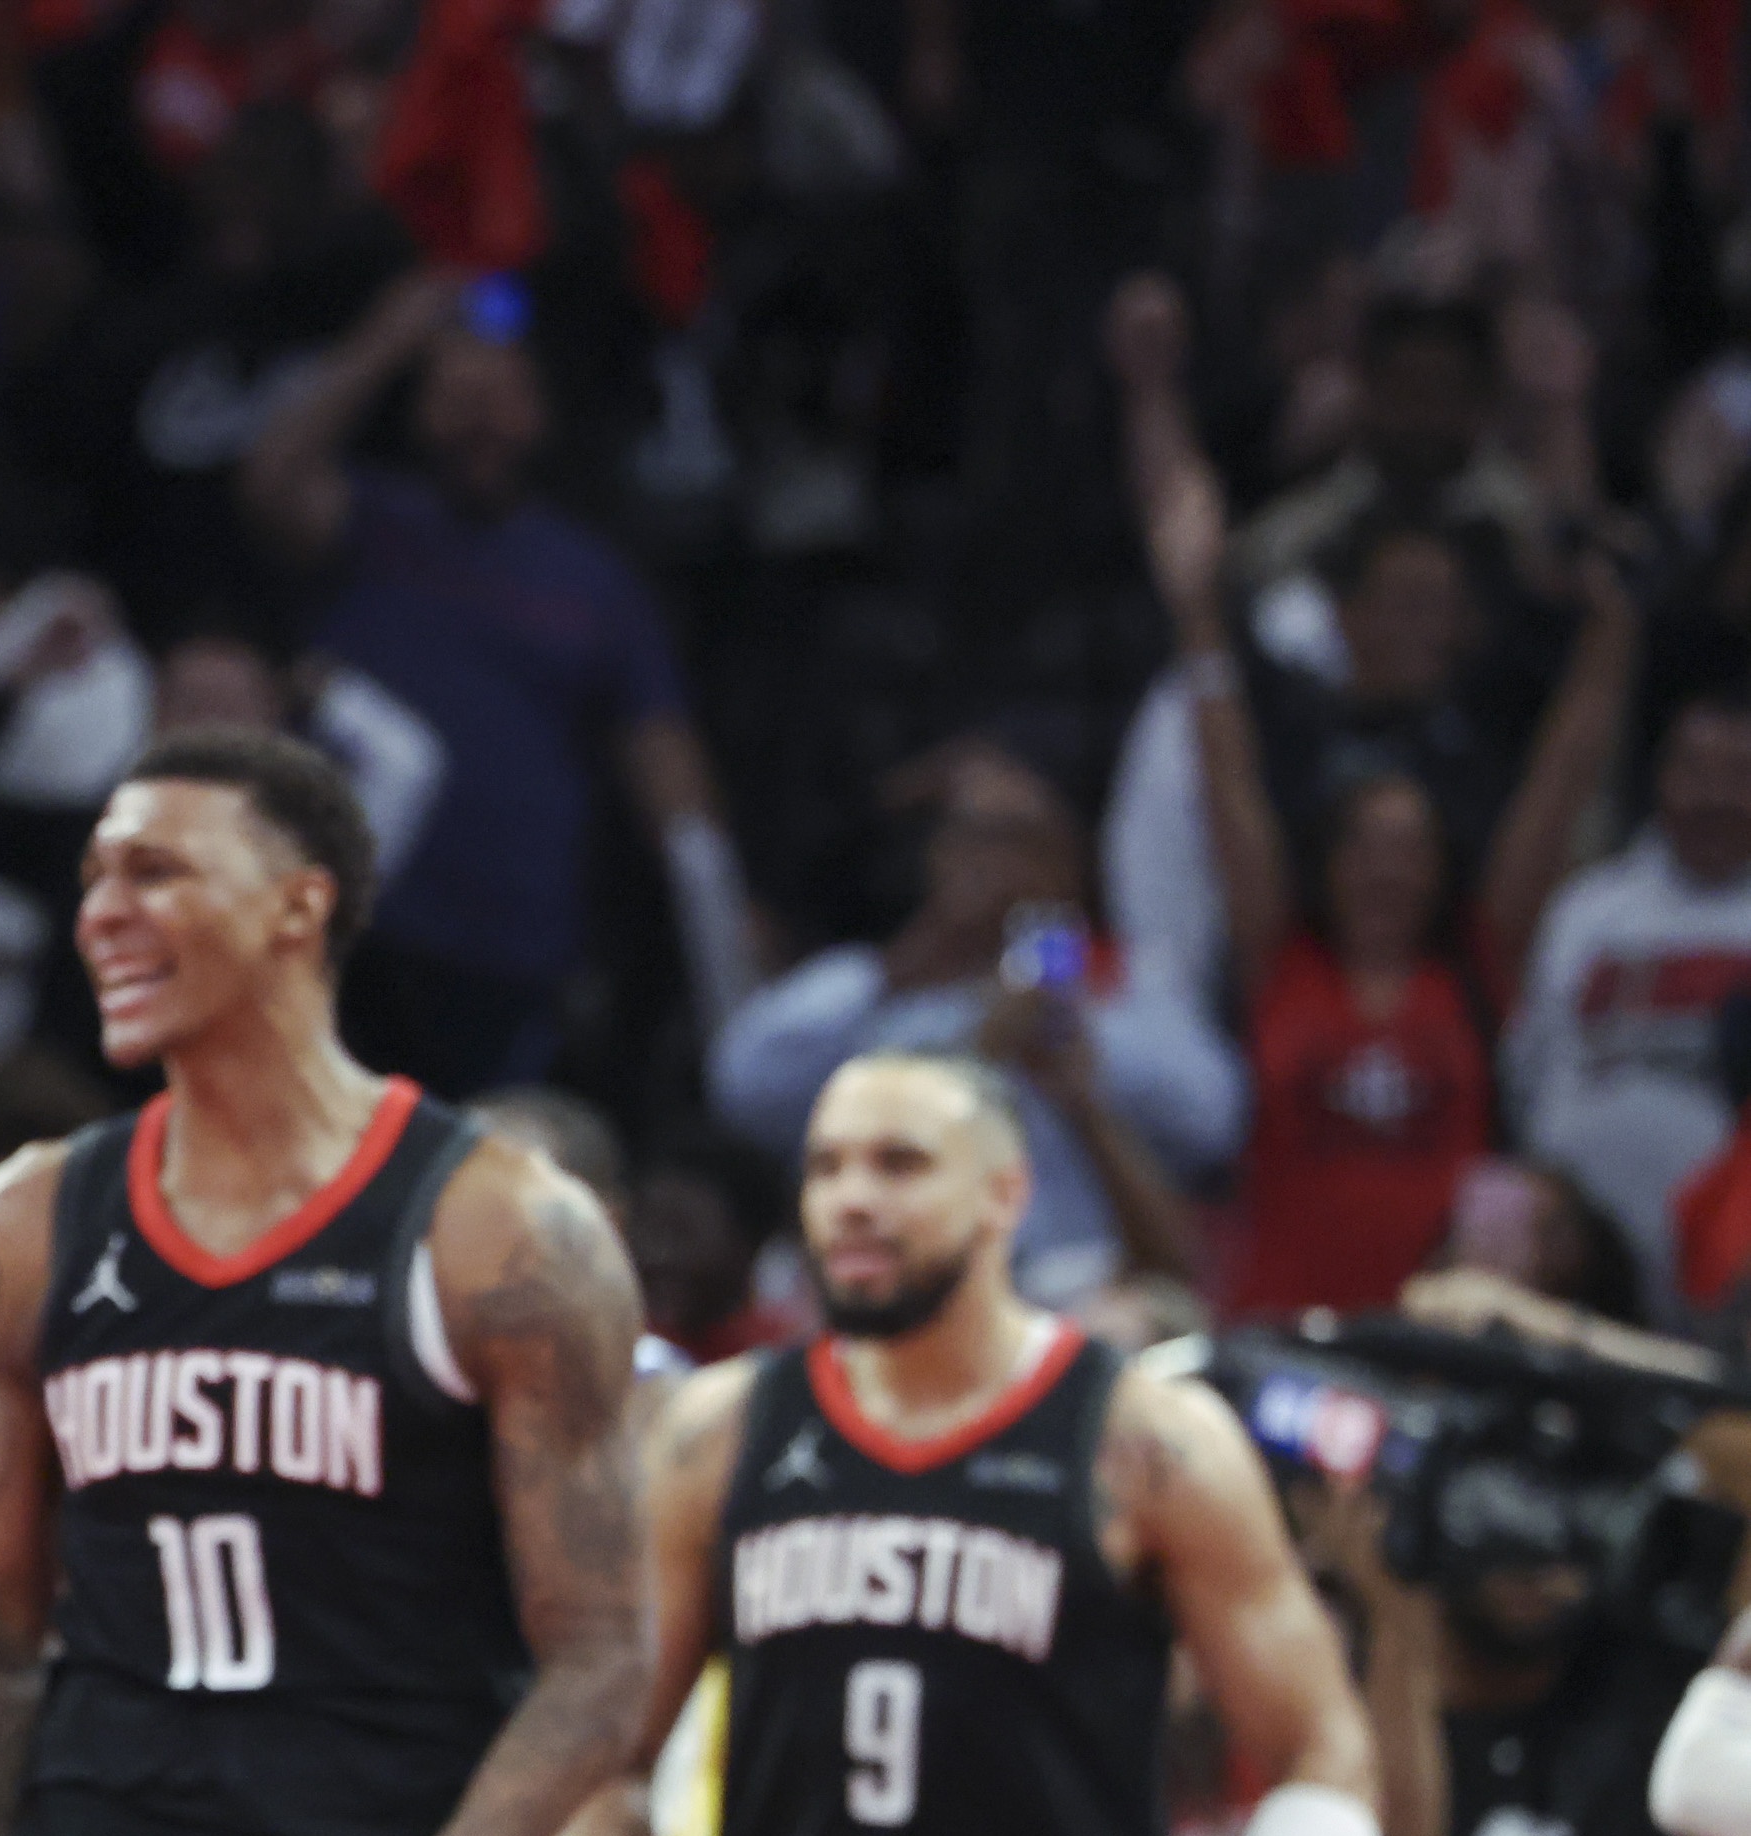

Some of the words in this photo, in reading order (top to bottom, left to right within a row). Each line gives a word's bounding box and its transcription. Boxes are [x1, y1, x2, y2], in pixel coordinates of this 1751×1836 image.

[44, 1347, 384, 1498] HOUSTON
[147, 1513, 276, 1692] 10
[732, 1511, 1064, 1663] HOUSTON
[844, 1659, 923, 1828] 9
